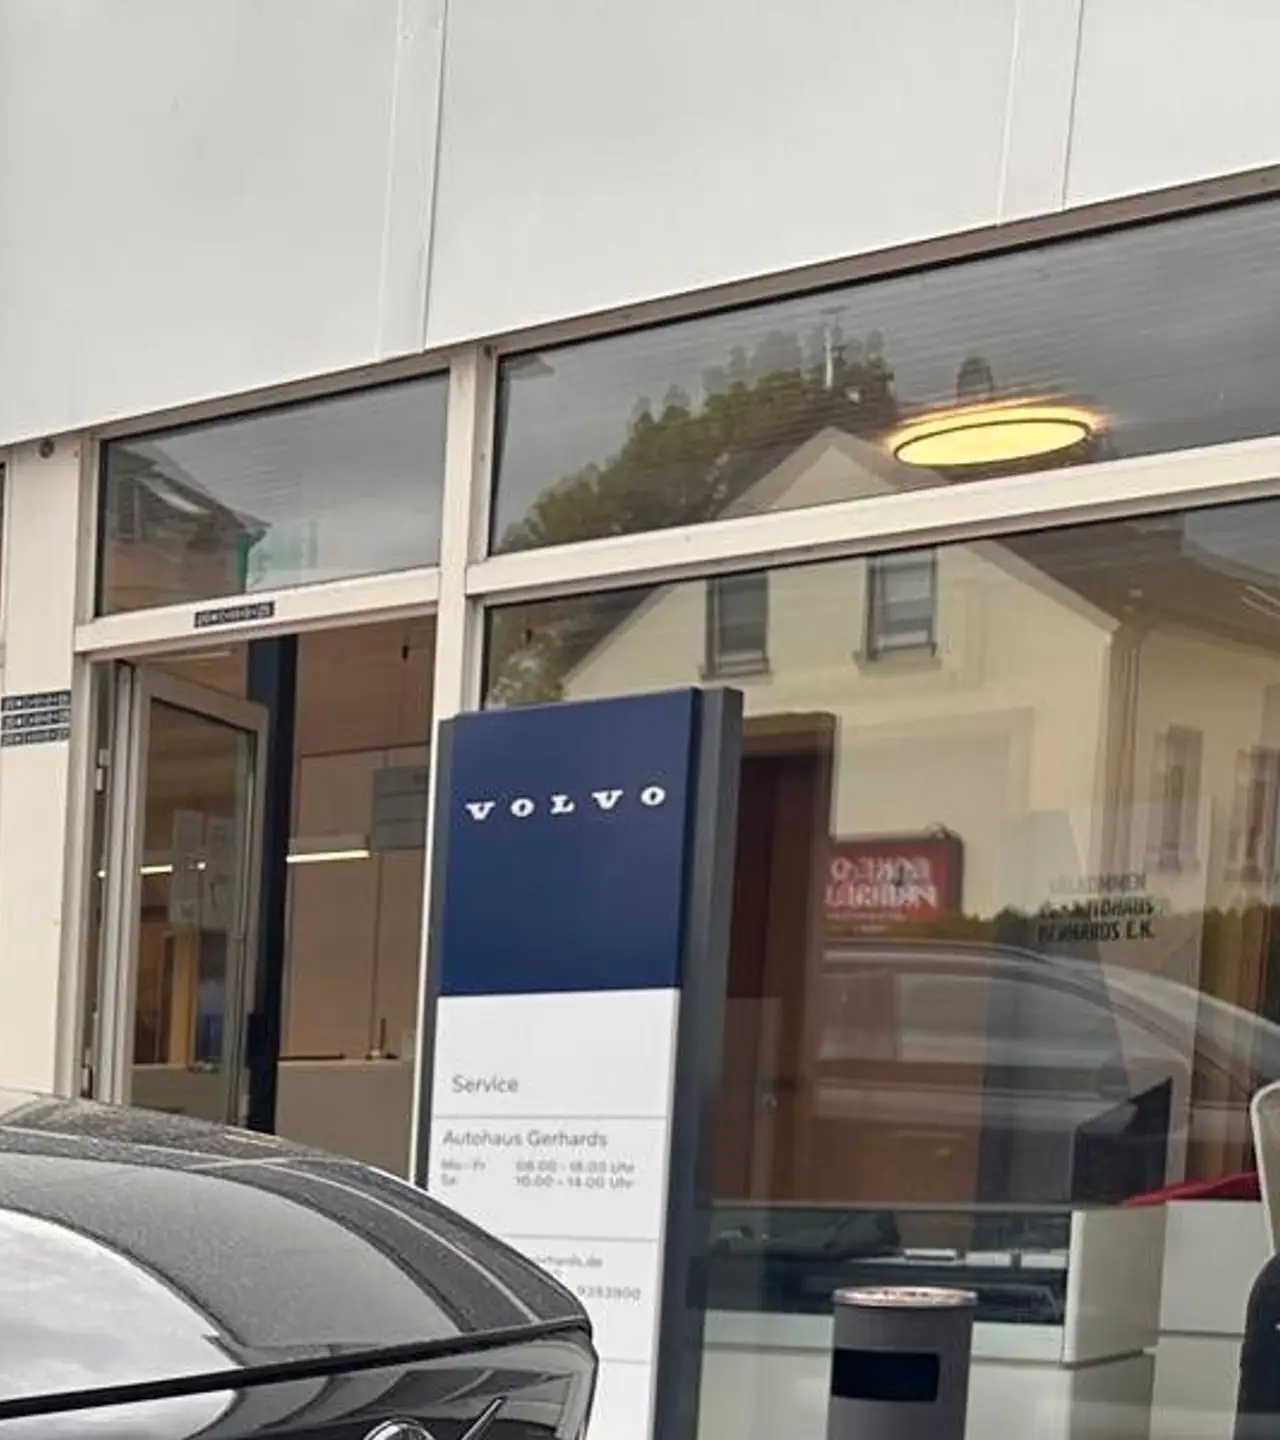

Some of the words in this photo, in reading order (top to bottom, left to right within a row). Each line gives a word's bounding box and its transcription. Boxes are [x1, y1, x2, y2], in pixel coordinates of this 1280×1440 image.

[465, 785, 666, 820] VOLVO
[452, 1074, 519, 1095] Service
[442, 1130, 523, 1147] Autohaus
[527, 1130, 608, 1149] Gerhards
